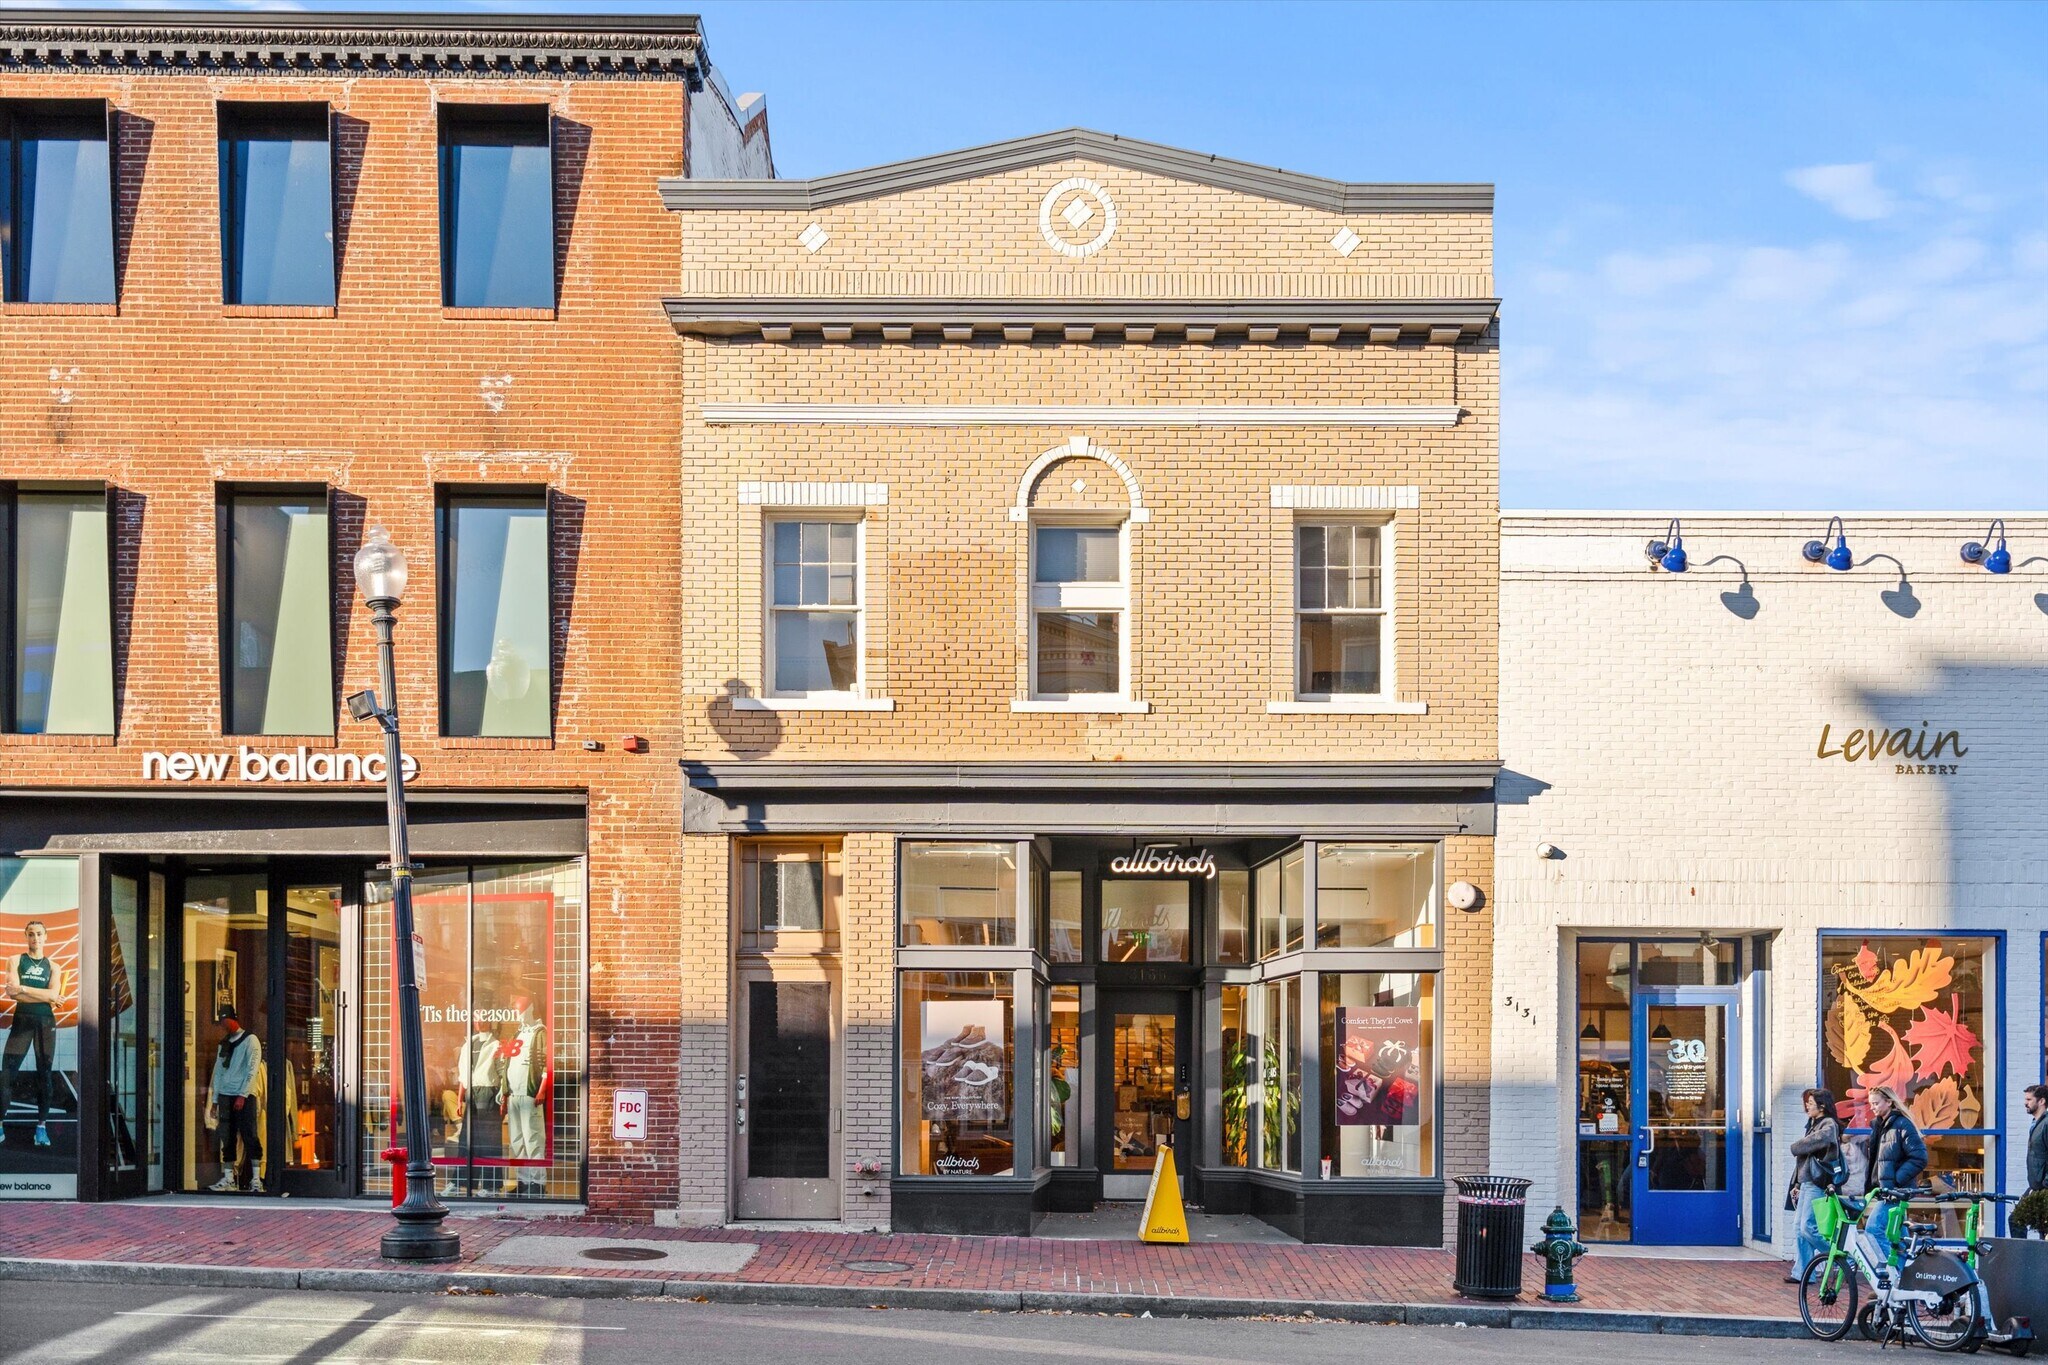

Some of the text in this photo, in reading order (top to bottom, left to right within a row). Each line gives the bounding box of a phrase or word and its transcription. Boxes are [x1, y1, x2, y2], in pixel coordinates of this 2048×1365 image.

[1817, 720, 1969, 762] Levain
[143, 745, 418, 783] new balance
[1895, 764, 1959, 775] BAKERY
[1111, 848, 1216, 880] allbirds
[446, 1003, 468, 1023] the
[1504, 996, 1536, 1026] 3131
[1341, 1016, 1414, 1026] Comfort They'll Covet
[619, 1102, 641, 1113] FDC
[927, 1100, 999, 1111] Cozy, Everywhere
[936, 1155, 980, 1170] allbirds
[1361, 1157, 1404, 1169] allbirds
[14, 1182, 51, 1191] balance
[1151, 1226, 1180, 1236] allbirds
[1923, 1272, 1936, 1280] Lime
[1942, 1274, 1958, 1283] Uber
